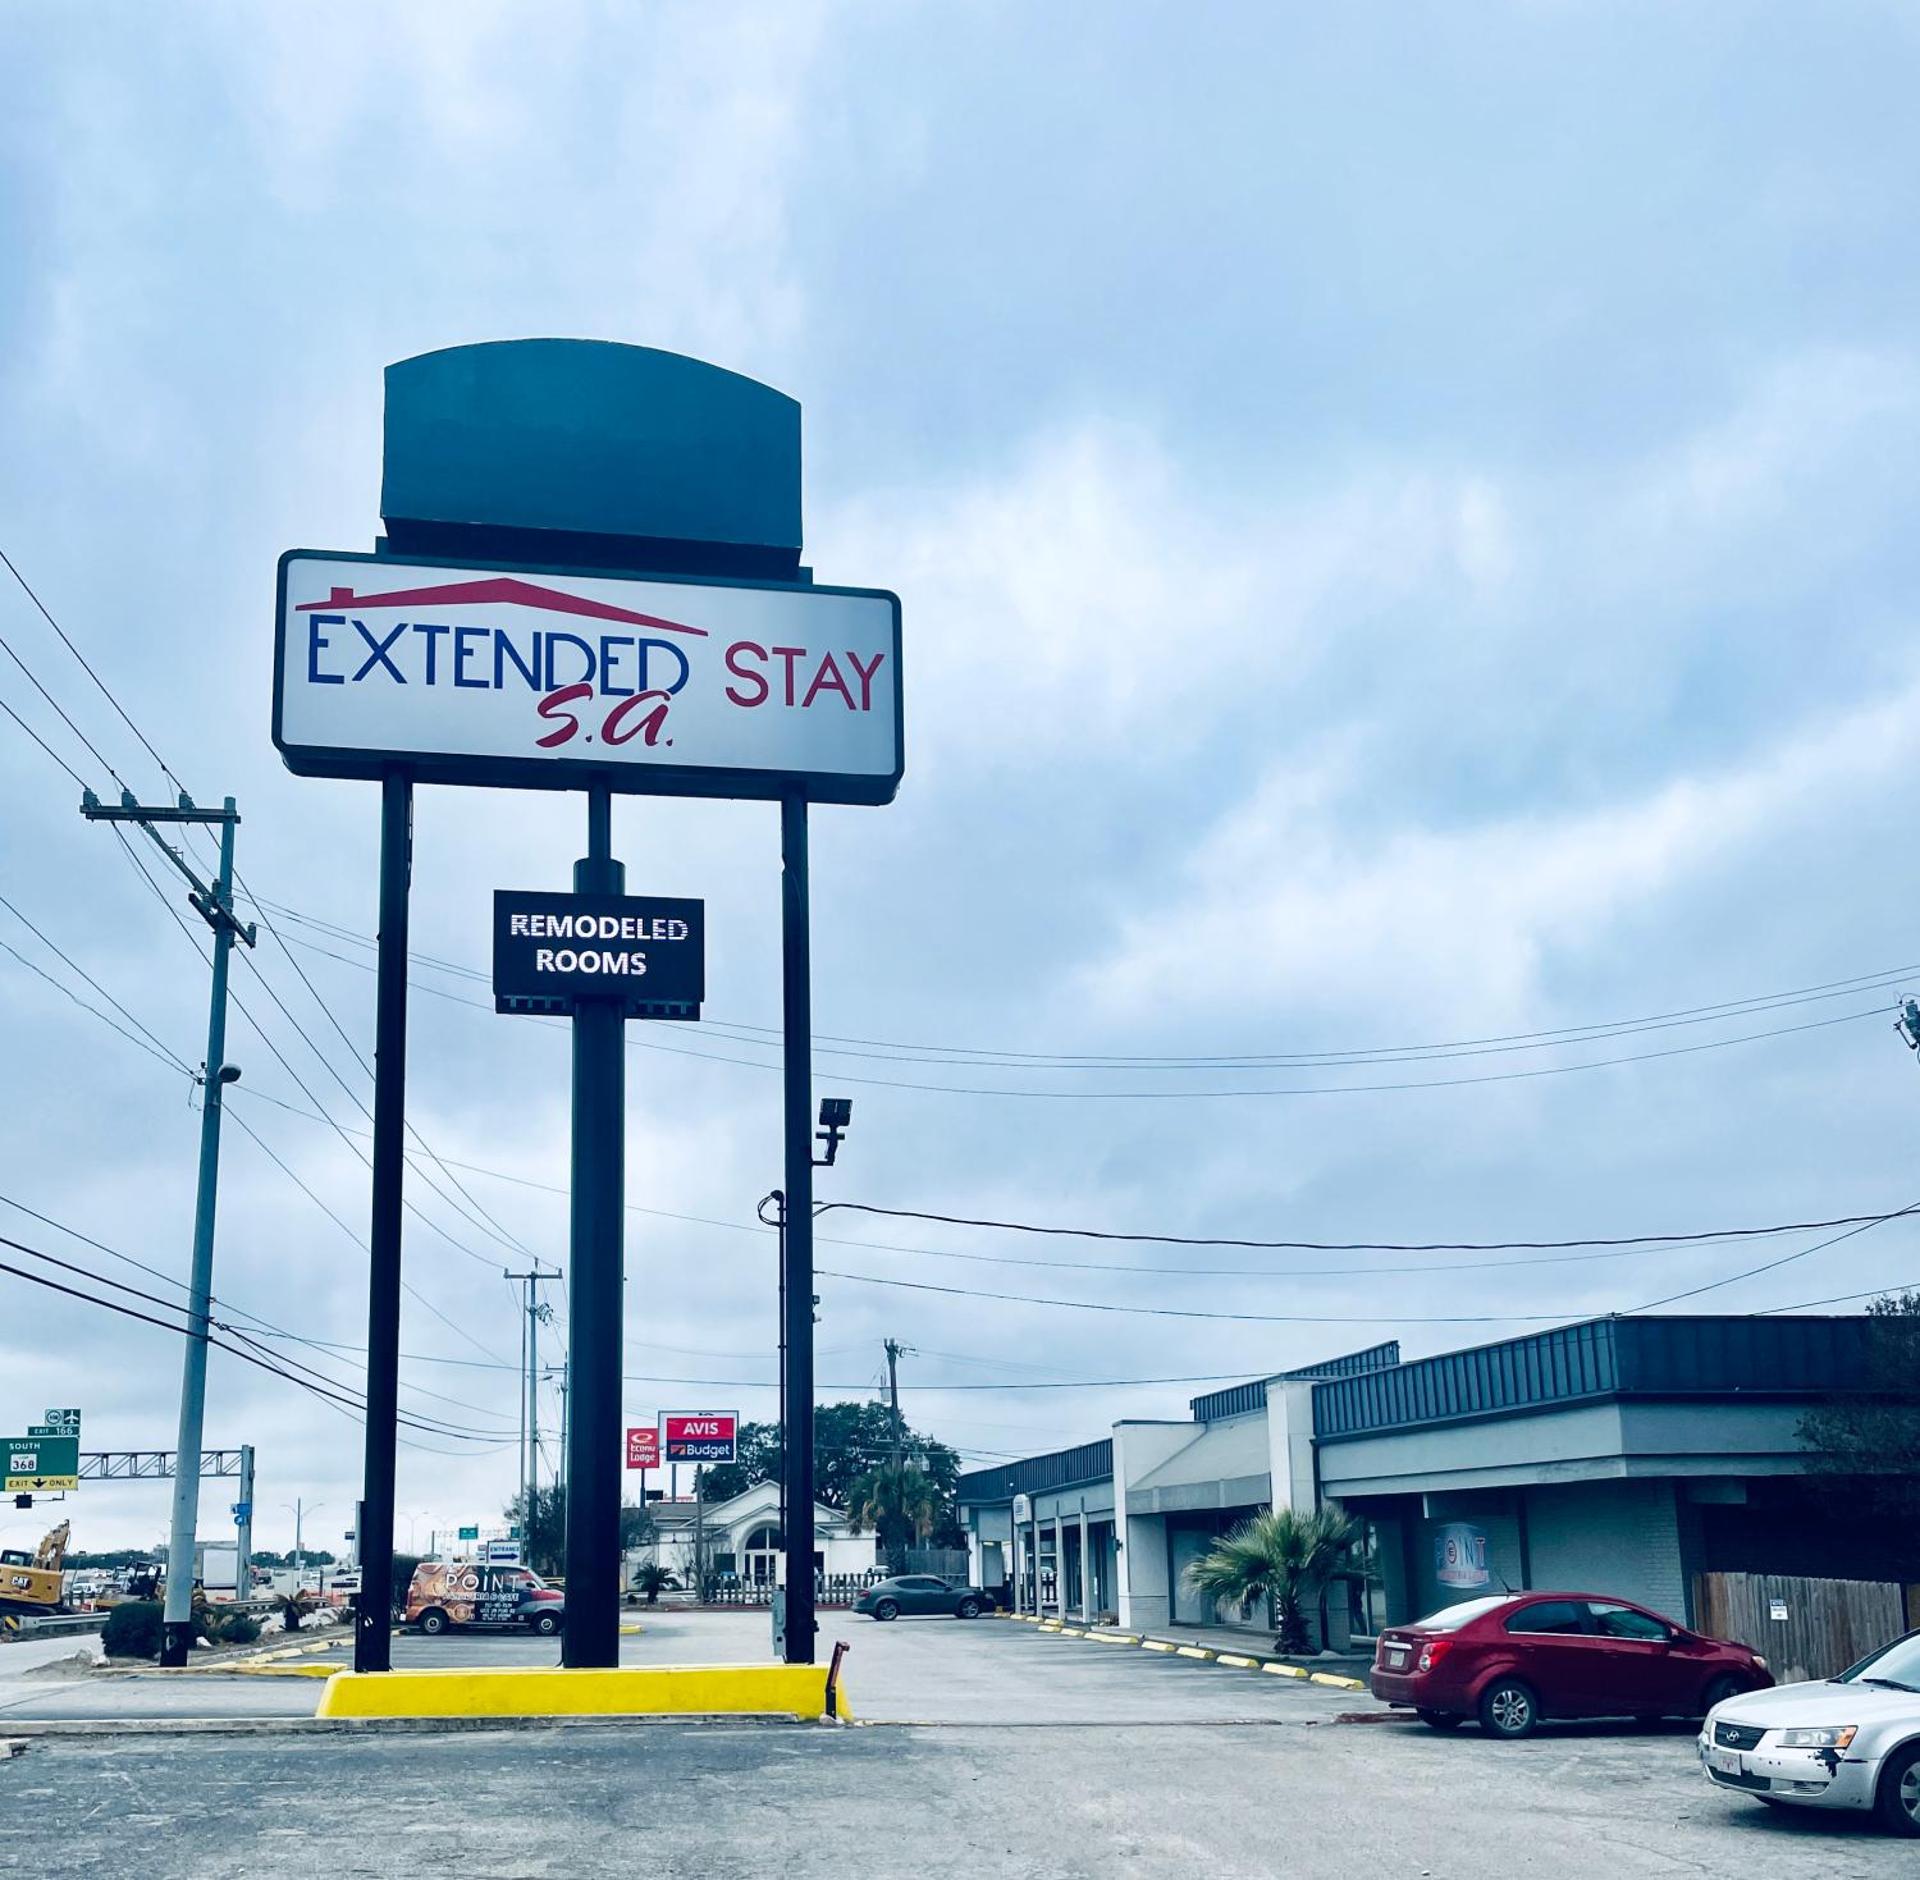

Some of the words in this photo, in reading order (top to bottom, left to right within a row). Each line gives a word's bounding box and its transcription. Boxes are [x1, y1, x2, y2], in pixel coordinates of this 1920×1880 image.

[308, 614, 690, 697] EXTENDED
[724, 641, 886, 712] STAY
[510, 914, 690, 941] REMODELED
[536, 948, 648, 976] ROOMS
[683, 1422, 719, 1435] AVIS
[9, 1442, 41, 1450] SOUTH
[687, 1444, 730, 1458] Budget
[12, 1460, 35, 1470] 368
[9, 1480, 28, 1488] EXIT
[11, 1576, 29, 1587] CAT
